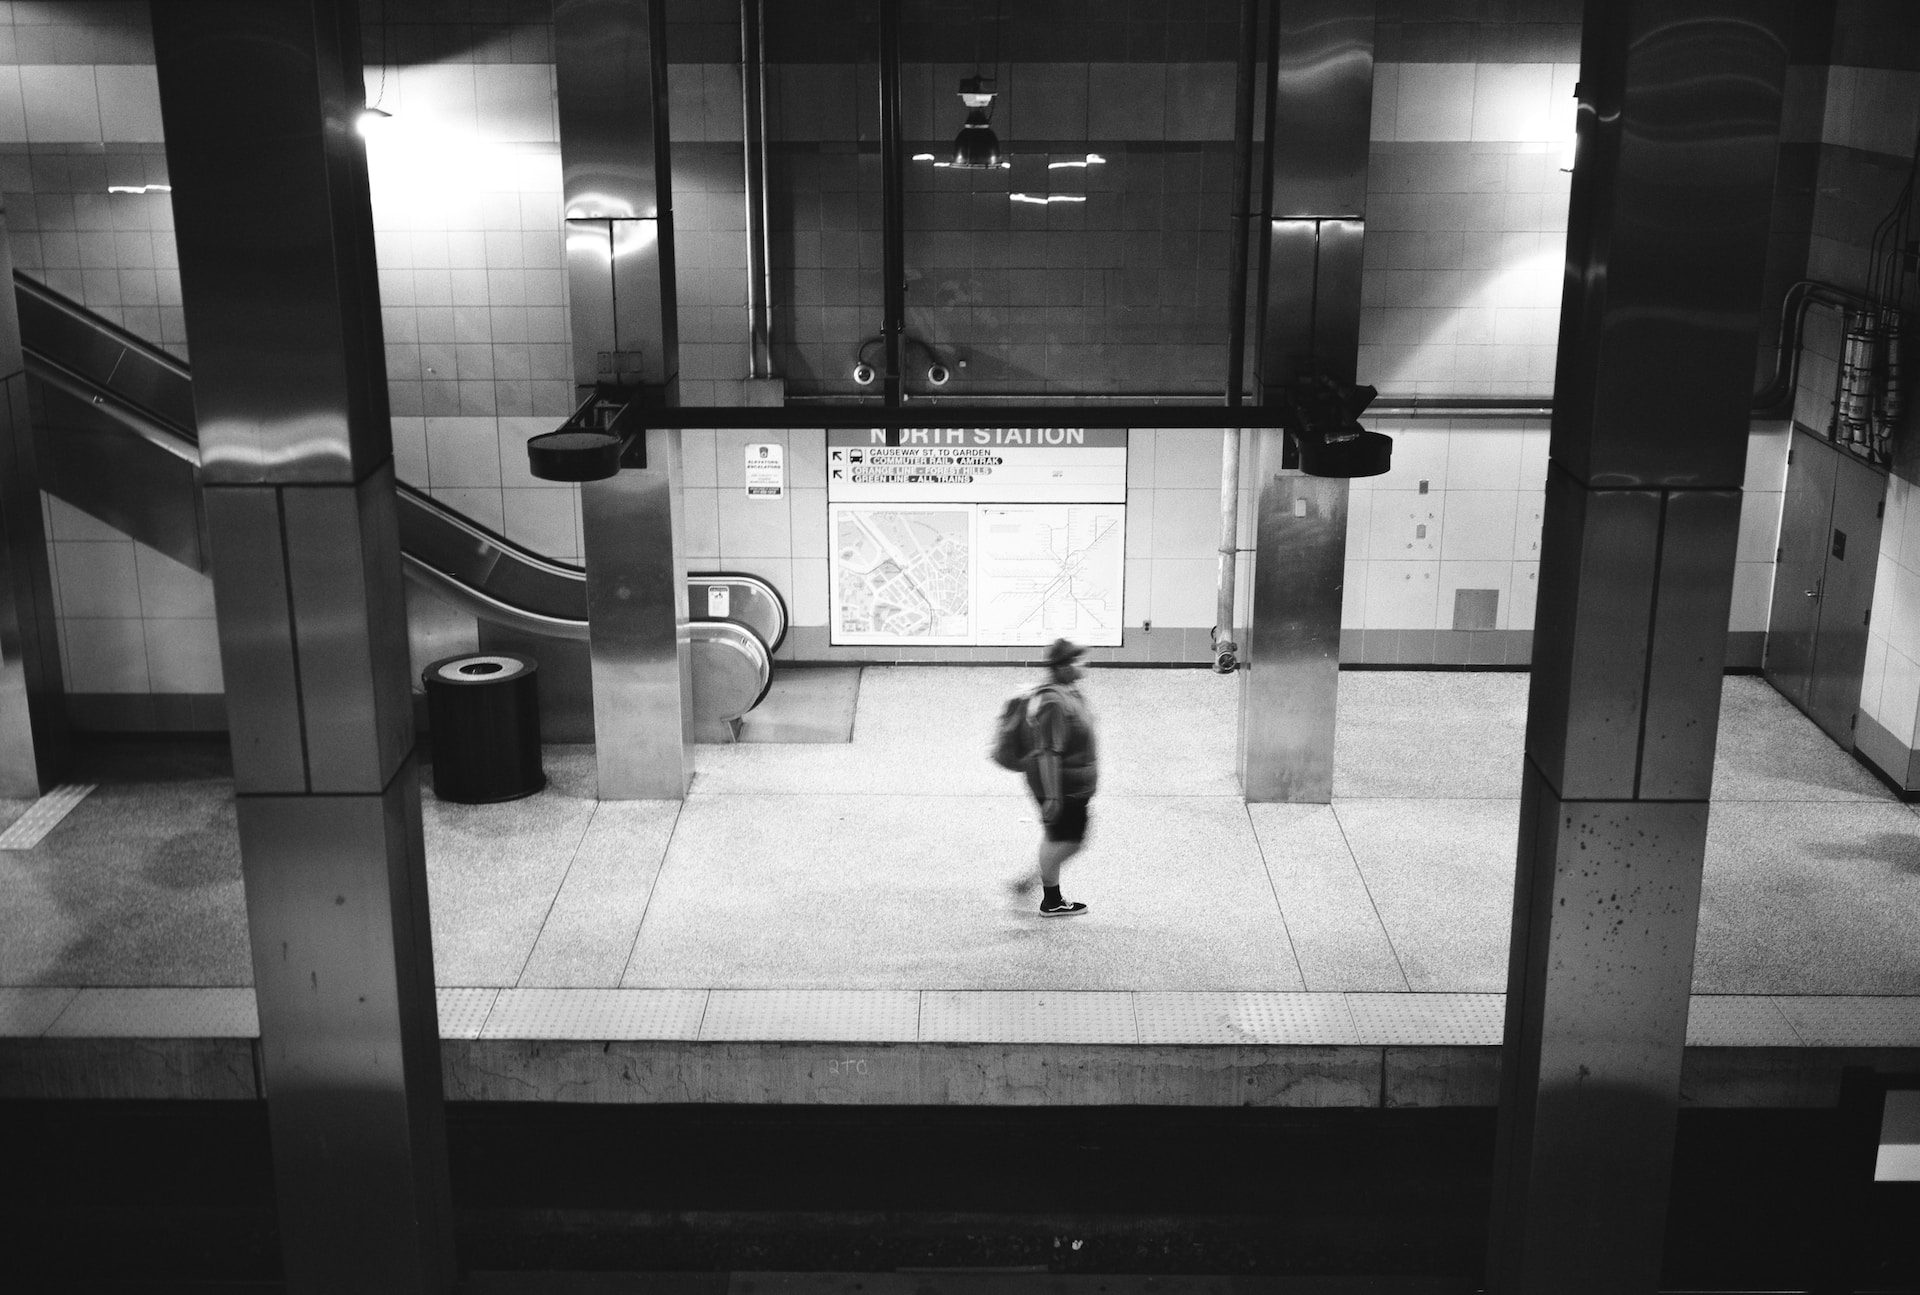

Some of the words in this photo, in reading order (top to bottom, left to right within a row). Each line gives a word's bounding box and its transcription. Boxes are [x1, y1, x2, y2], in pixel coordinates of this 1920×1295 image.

[973, 429, 1084, 444] STATION
[873, 457, 927, 465] COMMUTER
[929, 457, 951, 465] RAIL
[960, 457, 998, 465] AMTRAK
[855, 467, 893, 475] ORANGE
[896, 467, 917, 475] LINE
[926, 467, 960, 475] FOREST
[963, 467, 988, 475] HILLS
[855, 475, 886, 483] GREEN
[889, 475, 909, 483] LINE
[918, 475, 935, 483] ALL
[937, 475, 970, 483] TRAINS
